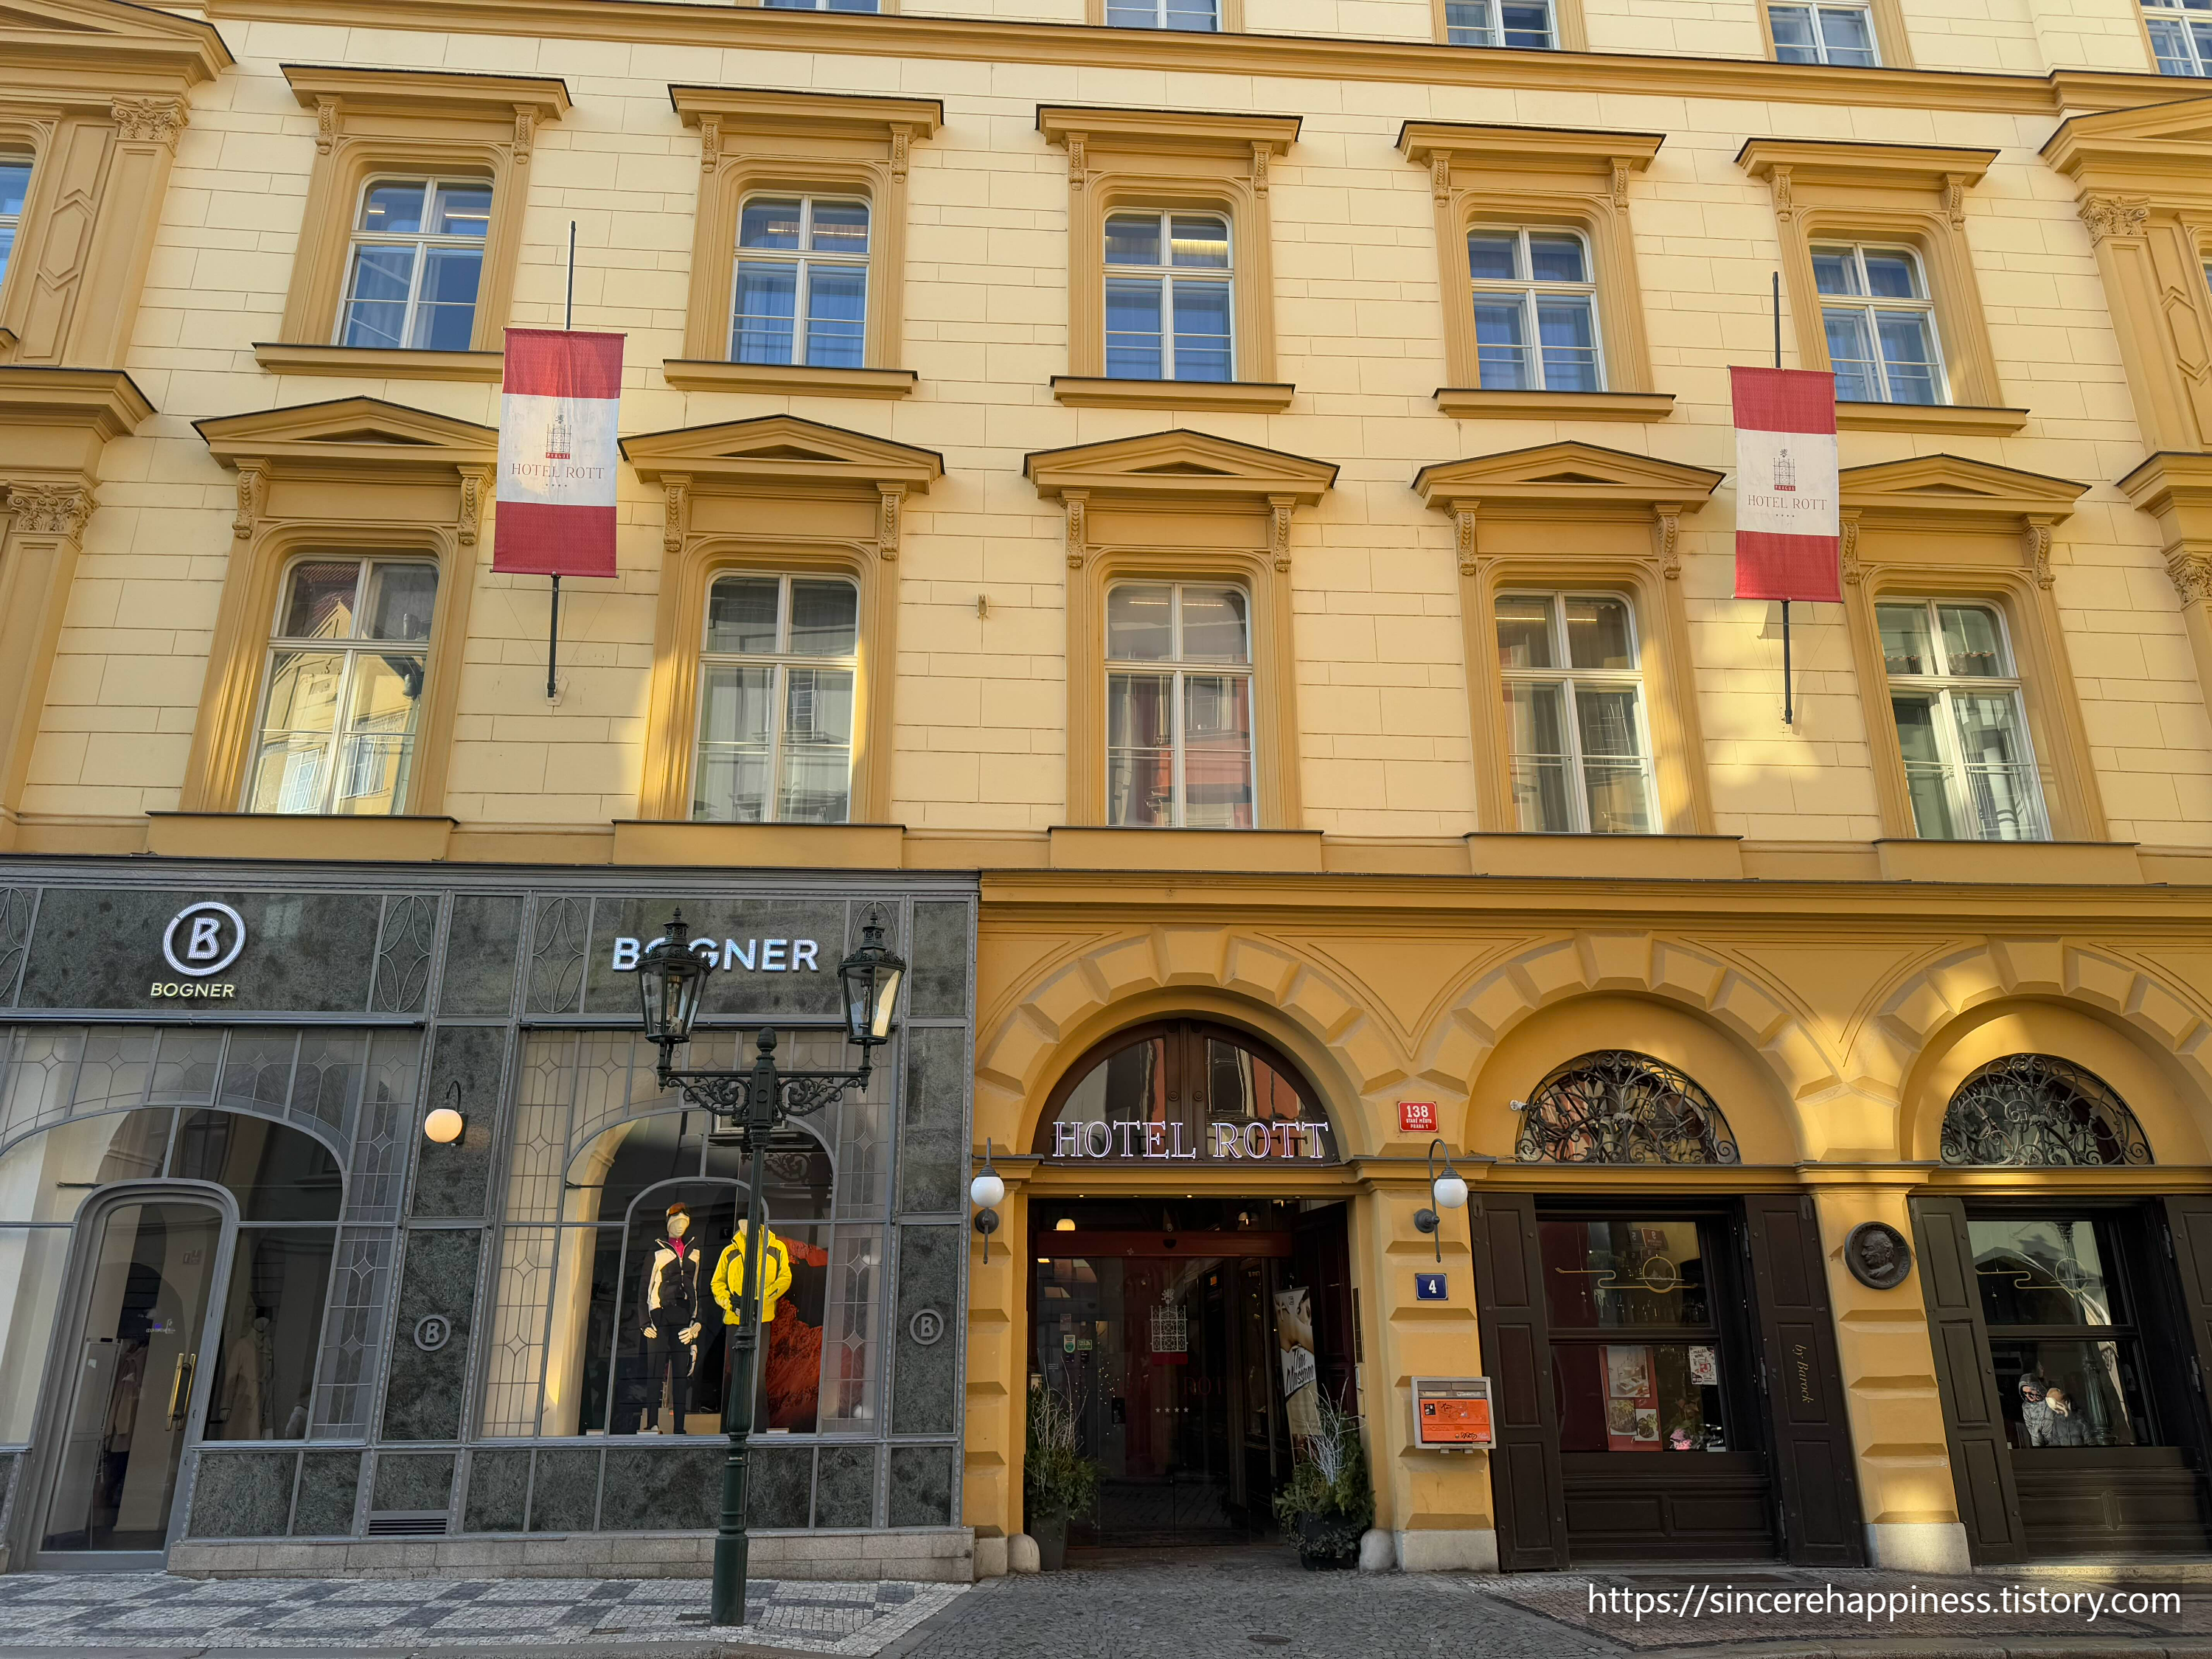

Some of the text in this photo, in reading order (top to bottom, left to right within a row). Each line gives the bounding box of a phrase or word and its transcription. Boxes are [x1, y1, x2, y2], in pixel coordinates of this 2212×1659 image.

[512, 463, 605, 479] HOTEL ROTT
[1747, 495, 1827, 510] HOTEL ROTT
[612, 936, 820, 972] BGNER
[150, 982, 236, 999] BOGNER
[1407, 1105, 1429, 1118] 138
[1053, 1120, 1329, 1159] HOTEL ROTT
[1429, 1279, 1437, 1294] 4
[1792, 1344, 1814, 1403] by Barock
